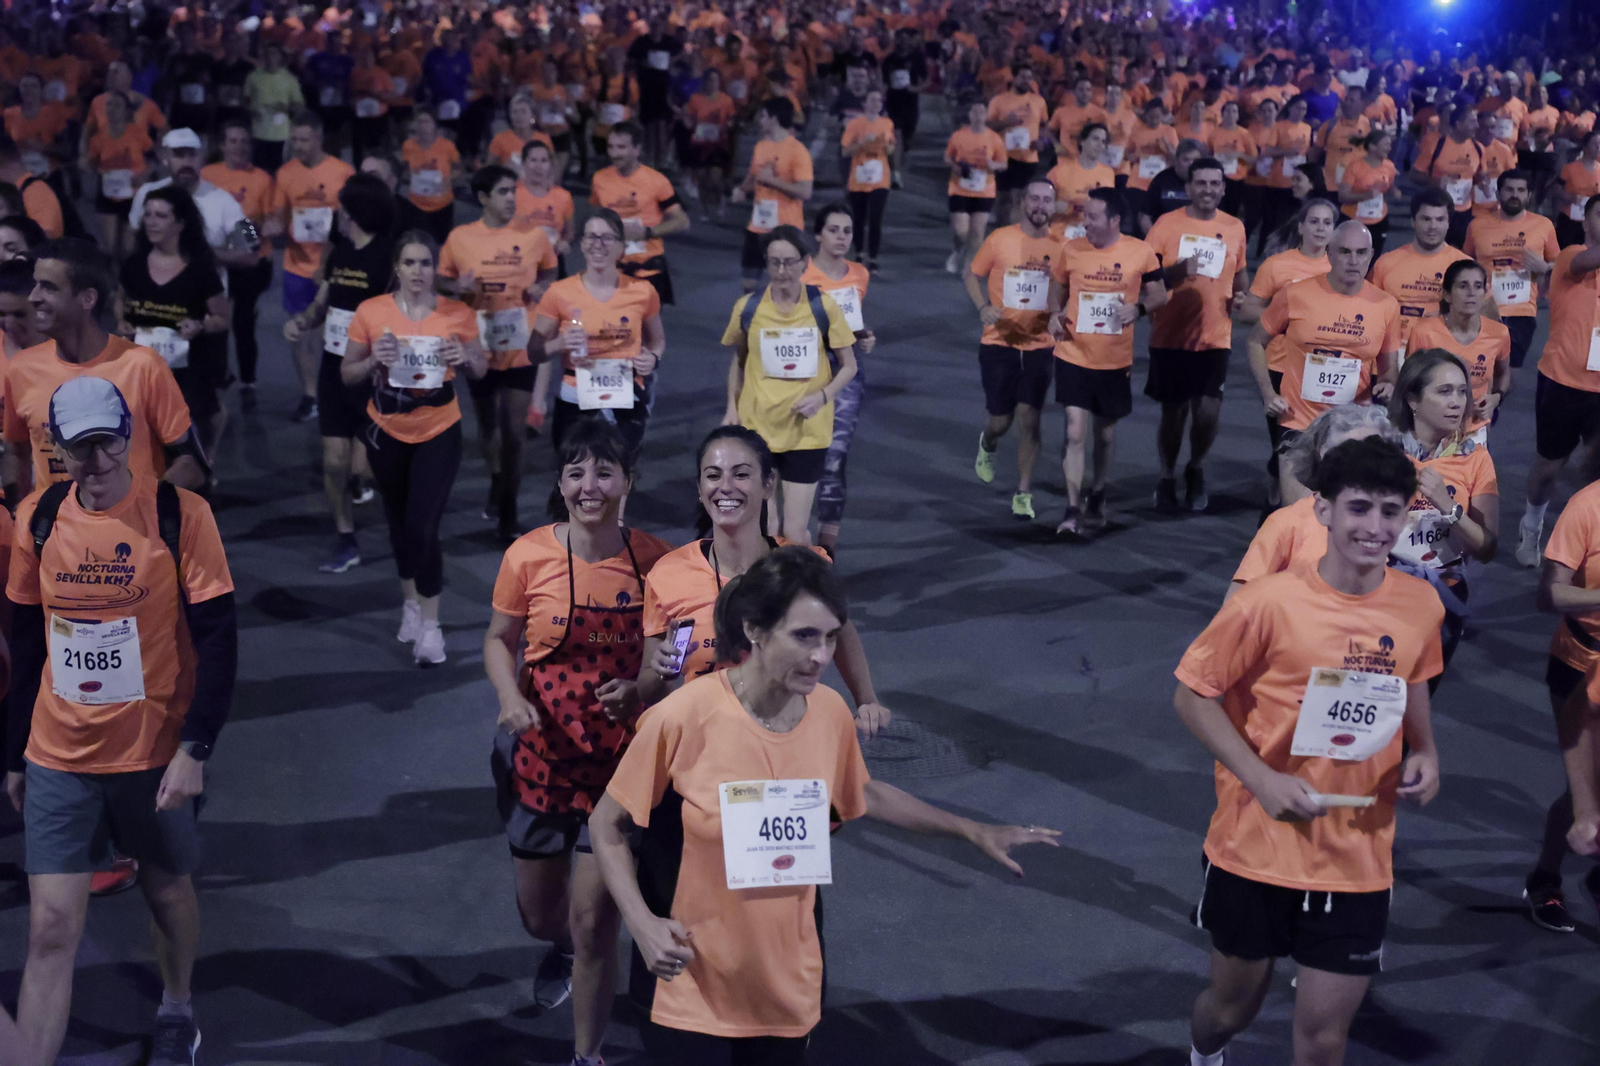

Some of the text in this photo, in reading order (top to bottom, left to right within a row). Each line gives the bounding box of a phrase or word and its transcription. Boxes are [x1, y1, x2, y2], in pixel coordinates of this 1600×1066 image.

[1192, 247, 1214, 261] 3640
[1015, 282, 1037, 294] 3641
[1502, 281, 1524, 291] 11903
[1090, 306, 1113, 317] 3643
[1317, 325, 1364, 337] SEVILLA KH7
[1333, 322, 1365, 332] NOCTURNA
[774, 345, 808, 358] 10831
[403, 354, 439, 367] 10040
[1319, 372, 1346, 386] 8127
[1409, 528, 1450, 546] 11664
[78, 563, 136, 574] NOCTURNA
[56, 573, 134, 587] SEVILLA KH7
[588, 632, 640, 644] SEVILLA
[64, 648, 122, 671] 21685
[1344, 656, 1396, 668] NOCTURNA
[1328, 700, 1378, 725] 4656
[758, 816, 807, 842] 4663
